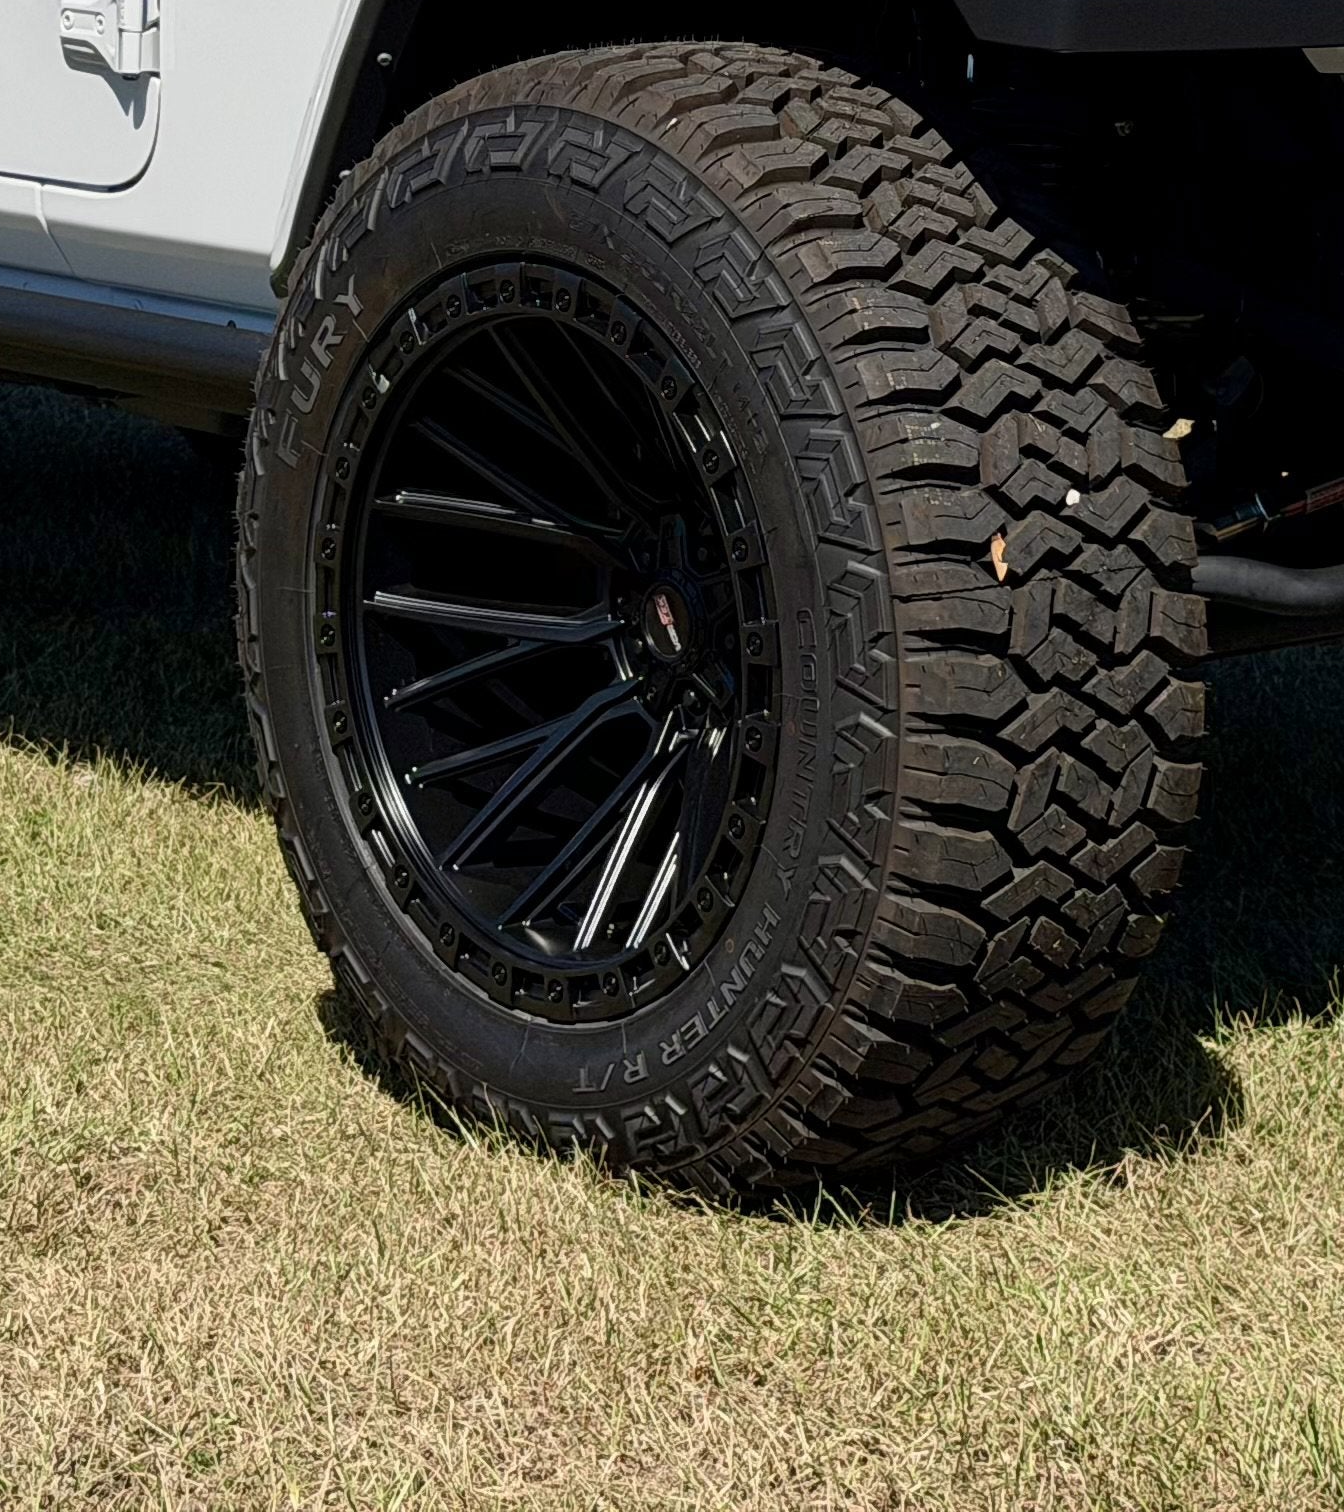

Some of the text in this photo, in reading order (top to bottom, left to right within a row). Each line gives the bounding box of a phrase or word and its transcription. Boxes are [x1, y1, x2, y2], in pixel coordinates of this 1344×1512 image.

[274, 273, 365, 469] FURY
[572, 607, 819, 1094] COUNTRY HUNTER R/T
